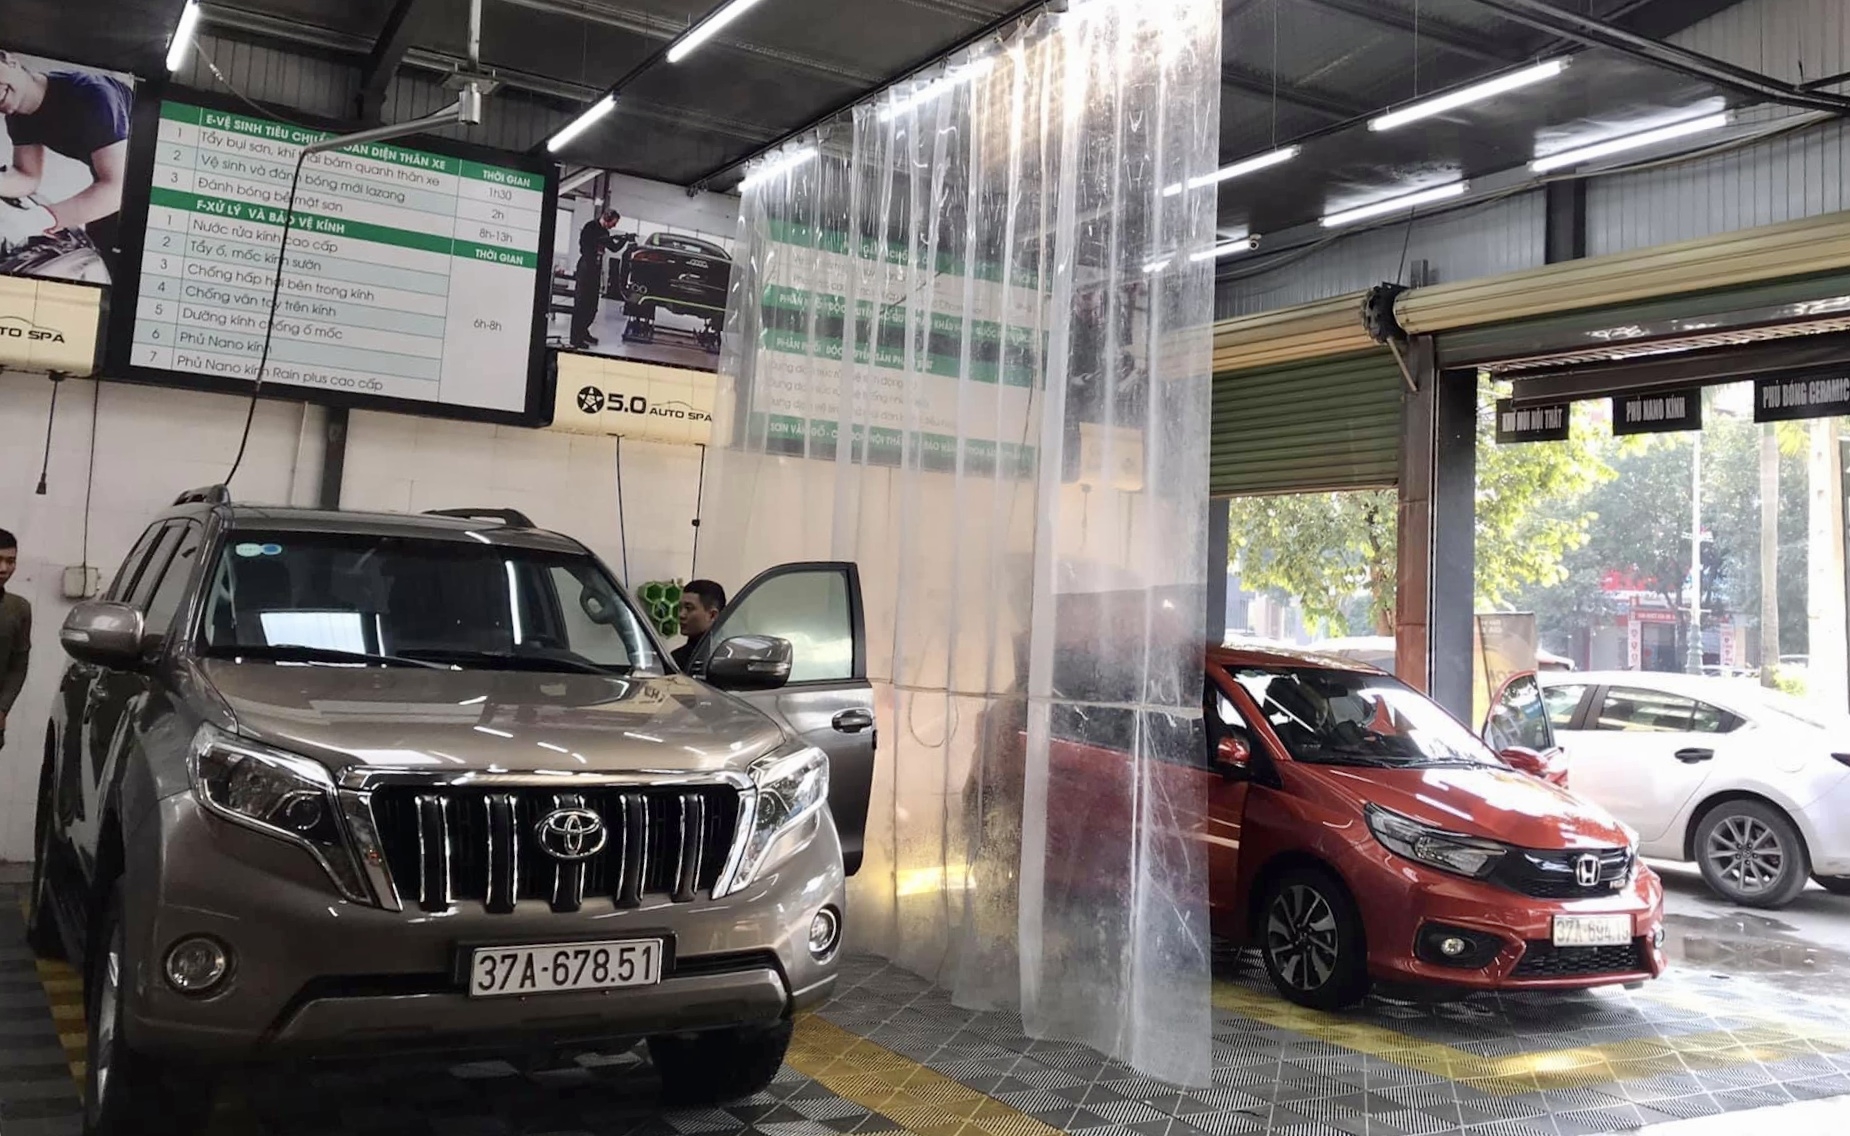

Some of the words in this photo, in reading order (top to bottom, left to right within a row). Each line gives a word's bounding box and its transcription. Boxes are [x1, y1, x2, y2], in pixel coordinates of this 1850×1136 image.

[206, 114, 230, 130] E-VỆ
[234, 120, 262, 134] SINH
[266, 125, 288, 140] TIÊU
[372, 147, 396, 162] DIỆN
[400, 152, 429, 167] THÂN
[432, 158, 446, 170] XE
[176, 128, 182, 138] 1
[201, 131, 222, 146] Tẩy
[278, 146, 295, 158] khí
[324, 154, 352, 170] bám
[355, 161, 394, 178] quanh
[397, 169, 423, 183] thân
[426, 177, 440, 186] xe
[173, 150, 181, 161] 2
[201, 154, 220, 170] Vệ
[222, 159, 246, 172] sinh
[250, 164, 266, 176] và
[304, 172, 338, 191] bóng
[366, 185, 405, 204] lazang
[506, 173, 530, 187] GIAN
[170, 172, 178, 184] 3
[198, 177, 234, 194] Đánh
[237, 183, 270, 201] bóng
[322, 200, 343, 212] sơn
[489, 187, 512, 201] 1h30
[228, 204, 242, 216] LÝ
[248, 206, 265, 220] VÀ
[298, 216, 313, 230] VỆ
[316, 218, 345, 234] KÍNH
[492, 208, 504, 220] 2h
[162, 236, 171, 248] 2
[191, 240, 212, 255] Tẩy
[232, 248, 261, 262] mốc
[167, 215, 172, 225] 1
[193, 219, 228, 235] Nước
[256, 229, 281, 244] kính
[285, 236, 310, 248] cao
[312, 240, 338, 254] cấp
[479, 228, 513, 244] 8h-13h
[500, 251, 524, 265] GIAN
[160, 259, 168, 270] 3
[188, 263, 232, 282] Chống
[236, 271, 261, 286] hấp
[265, 278, 284, 288] hi
[288, 280, 312, 292] bên
[316, 283, 348, 302] trong
[350, 288, 375, 302] kính
[158, 282, 166, 292] 4
[186, 285, 230, 304] Chống
[234, 292, 258, 306] vân
[285, 300, 309, 314] trên
[312, 304, 336, 317] kính
[154, 304, 162, 316] 5
[230, 312, 256, 328] kính
[315, 326, 343, 340] mốc
[473, 317, 502, 332] 6h-8h
[28, 330, 65, 344] SPA
[152, 329, 160, 340] 6
[180, 331, 205, 346] Phủ
[208, 335, 244, 350] Nano
[149, 351, 157, 362] 7
[178, 355, 202, 370] Phủ
[205, 359, 242, 374] Nano
[273, 368, 300, 382] Rain
[303, 372, 328, 386] plus
[330, 378, 355, 388] cao
[358, 378, 383, 392] cấp
[1809, 378, 1850, 404] CERAMIC
[607, 393, 647, 414] 5.0
[649, 407, 684, 419] AUTO
[688, 413, 712, 422] SPA
[478, 946, 652, 991] 37A-678.51
